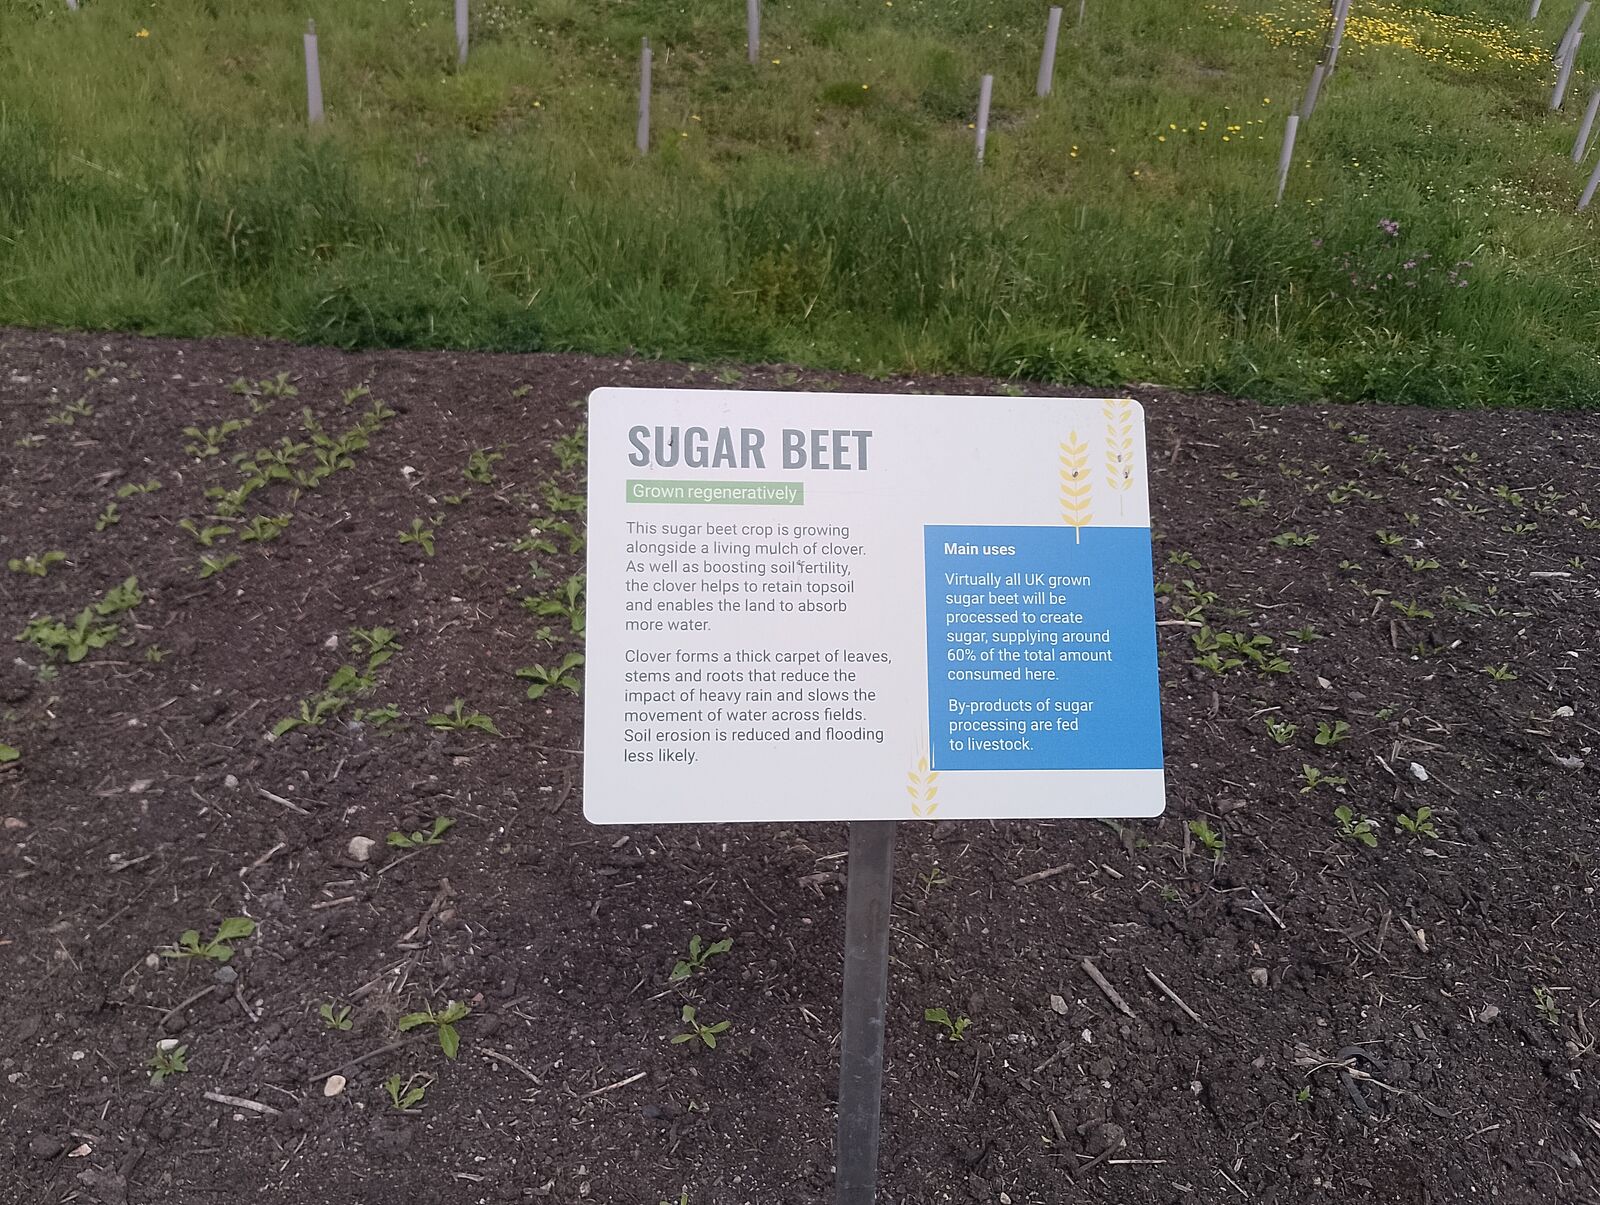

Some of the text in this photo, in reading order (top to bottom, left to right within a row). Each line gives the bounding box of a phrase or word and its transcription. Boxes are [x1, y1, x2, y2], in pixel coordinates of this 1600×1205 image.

[628, 425, 873, 471] SUGAR BEET
[633, 484, 797, 503] Grown regeneratively
[626, 521, 849, 540] This sugar beet crop is growing
[626, 540, 866, 557] alongside a living mulch of clover.
[944, 543, 1016, 555] Main uses
[626, 559, 851, 577] As well as boosting soil fertility,
[625, 578, 854, 596] the clover helps to retain topsoil
[945, 572, 1090, 589] Virtually all UK grown
[626, 598, 847, 612] and enables the land to absorb
[946, 591, 1066, 607] sugar beet will be
[626, 619, 711, 631] more water.
[946, 610, 1083, 626] processed to create
[947, 629, 1110, 645] sugar, supplying around
[625, 649, 891, 666] Clover forms a thick carpet of leaves,
[947, 648, 1112, 661] 60% of the total amount
[625, 668, 856, 682] stems and roots that reduce the
[948, 667, 1059, 680] consumed here.
[625, 688, 876, 705] impact of heavy rain and slows the
[624, 707, 866, 722] movement of water across fields.
[949, 698, 1094, 715] By-products of sugar
[949, 717, 1078, 734] processing are fed
[624, 727, 884, 743] Soil erosion is reduced and flooding
[949, 737, 1033, 751] to livestock.
[624, 748, 698, 765] less likely.
